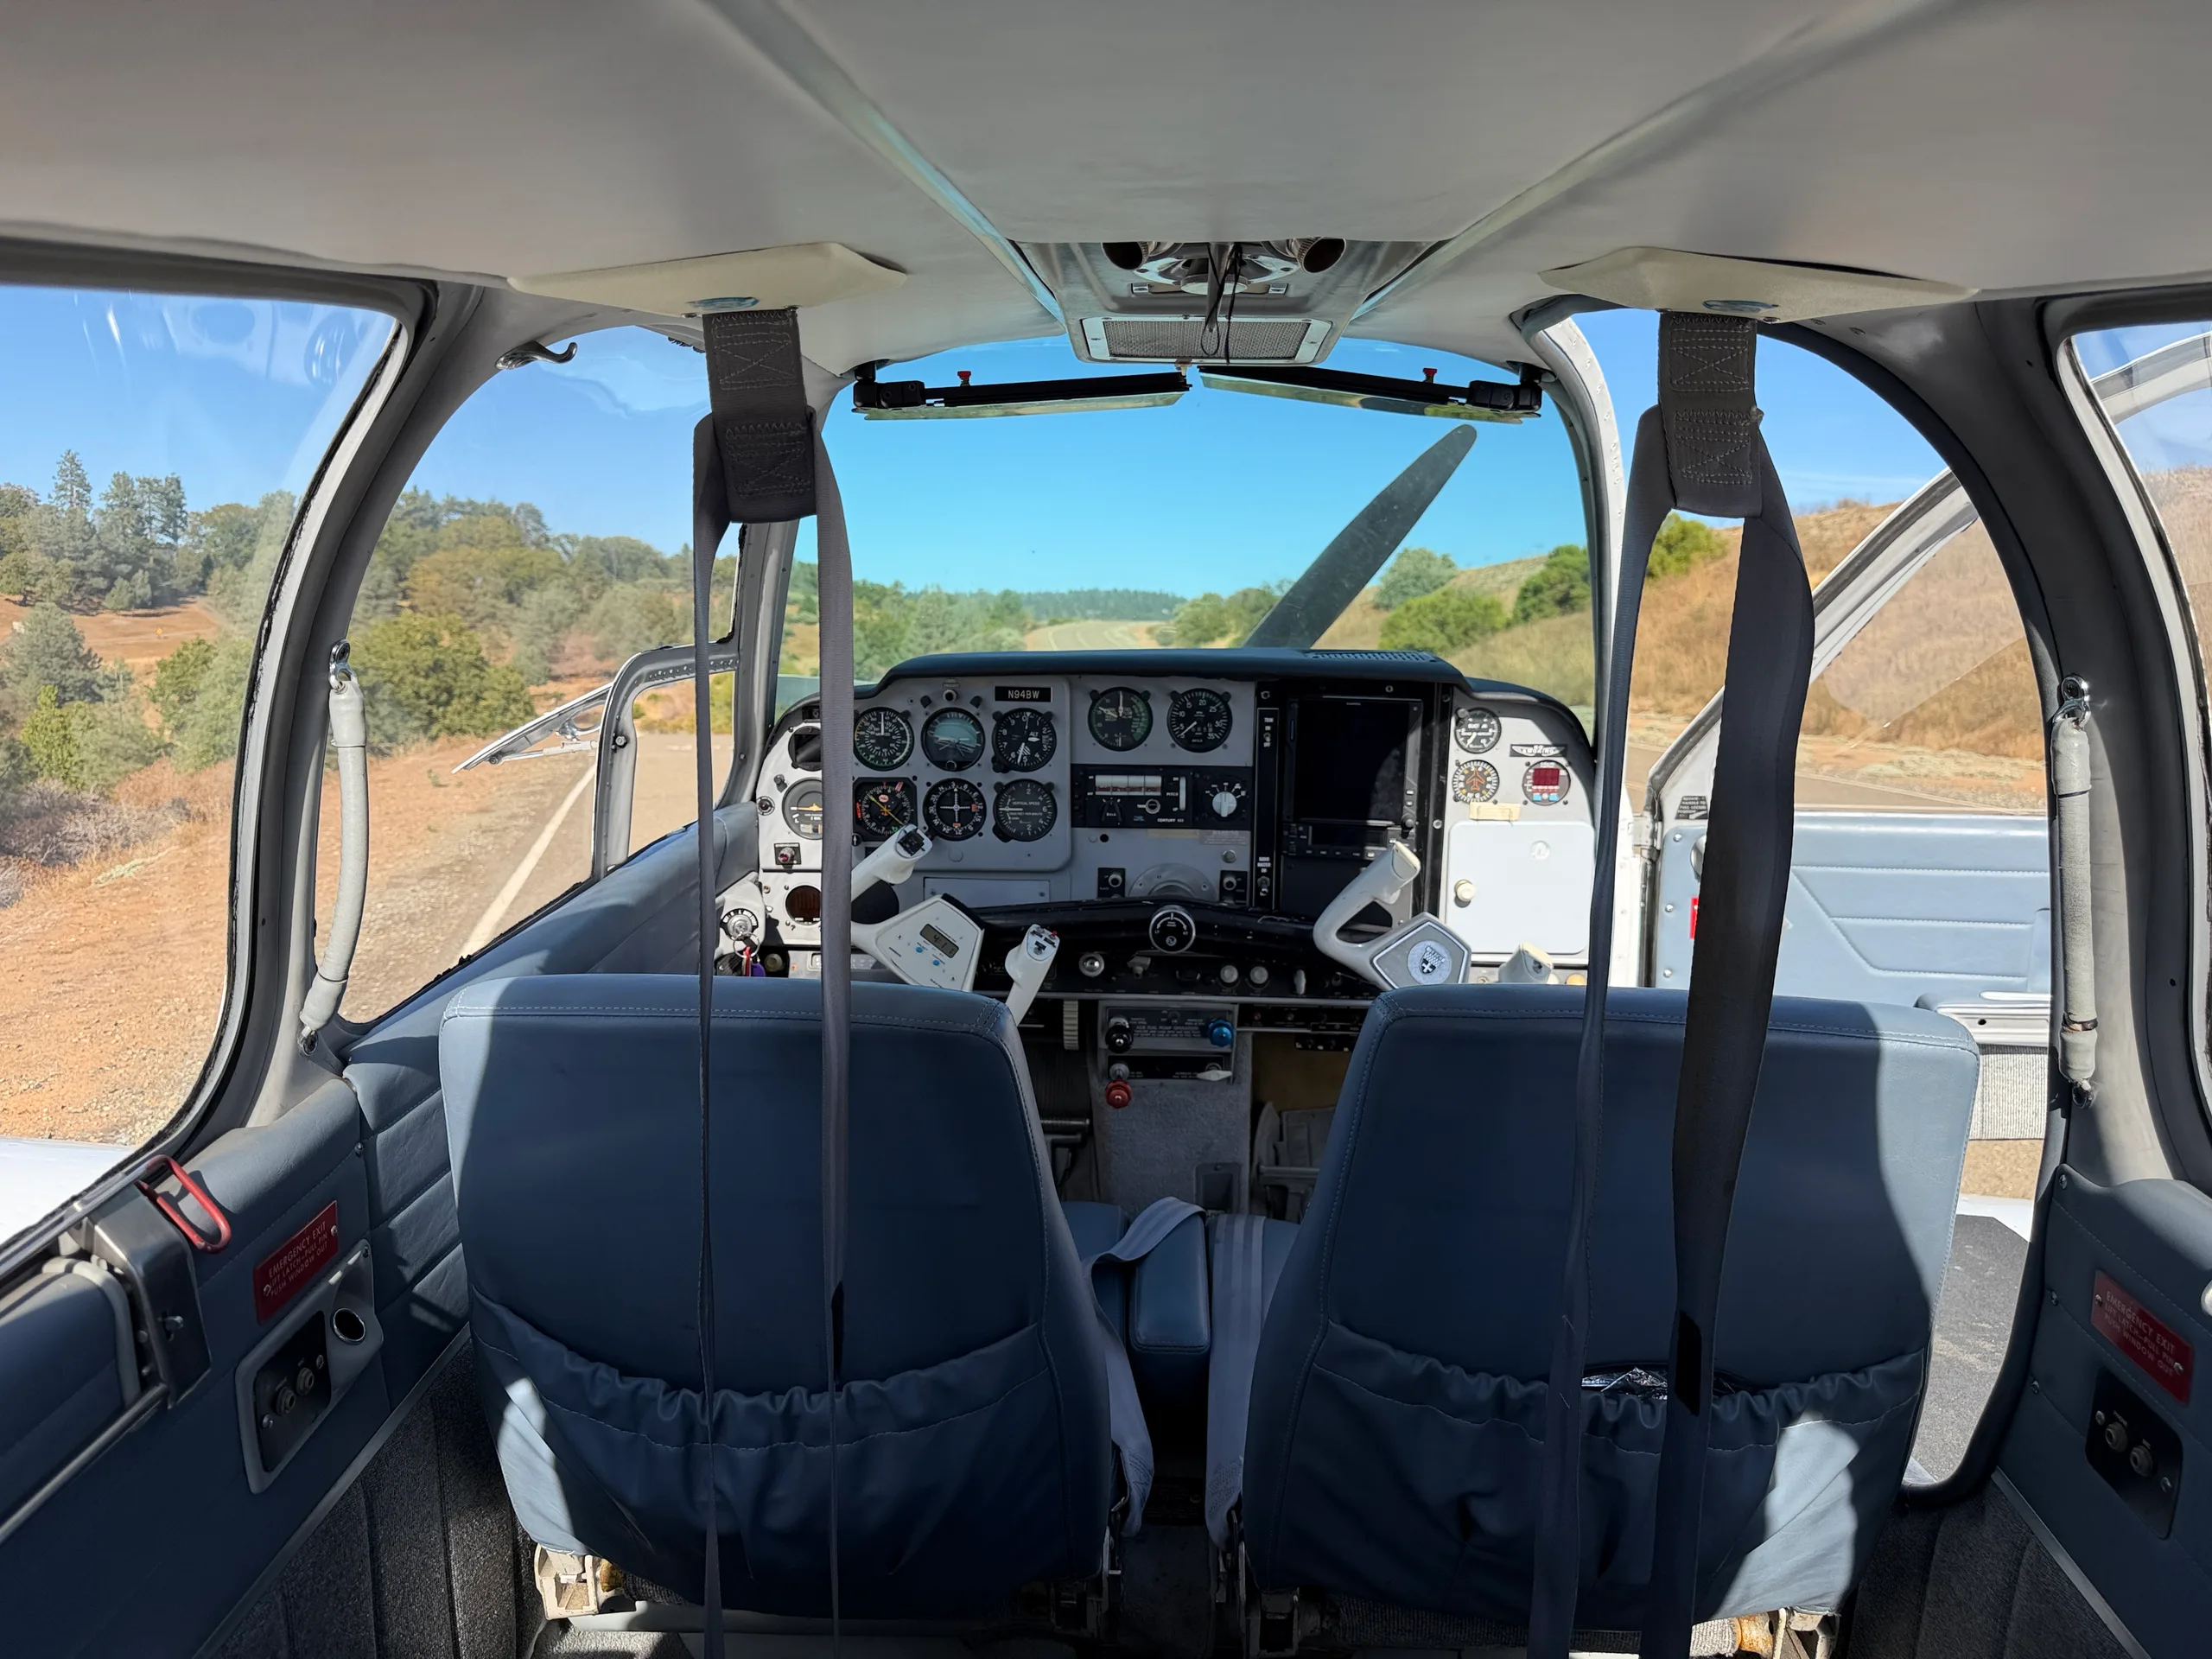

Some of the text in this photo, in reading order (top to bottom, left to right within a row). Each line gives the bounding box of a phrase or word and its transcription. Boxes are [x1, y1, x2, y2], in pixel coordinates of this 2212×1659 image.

[1007, 690, 1039, 699] N94BW
[268, 1221, 326, 1278] EMERGENCY EXIT
[269, 1274, 281, 1288] LIFT
[318, 1232, 327, 1244] PIN
[270, 1242, 327, 1300] PUSH WINDOW OUT
[2104, 1313, 2175, 1376] PUSH WINDOW OUT
[2105, 1302, 2117, 1315] LIFT
[2162, 1351, 2175, 1366] PIN
[2106, 1291, 2176, 1355] EMERGENCY EXIT
